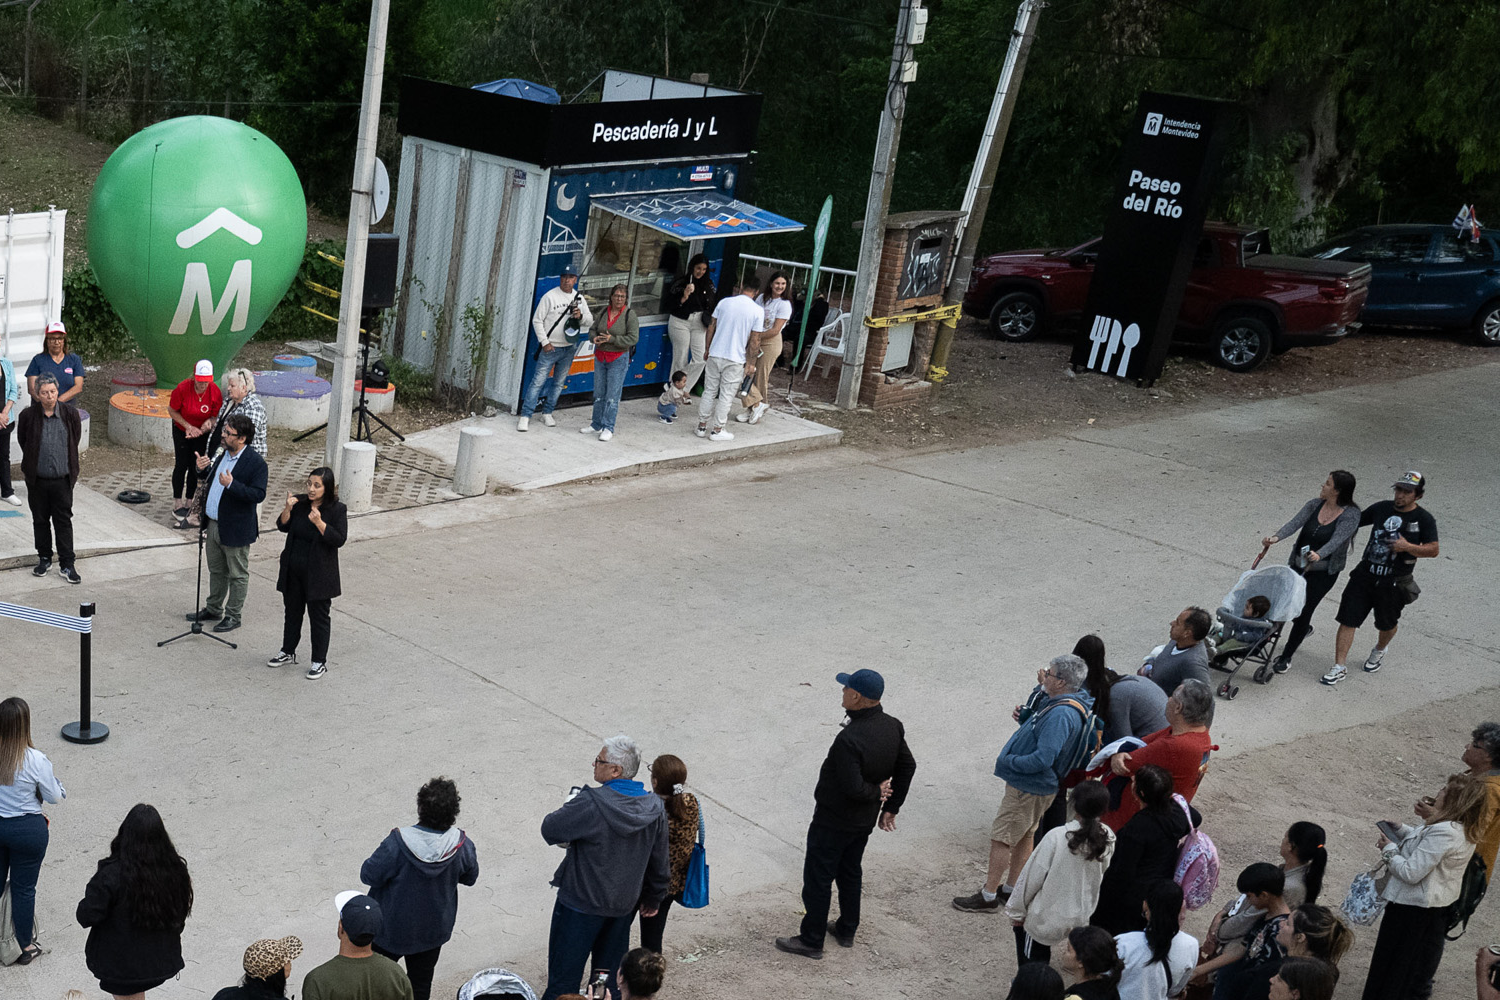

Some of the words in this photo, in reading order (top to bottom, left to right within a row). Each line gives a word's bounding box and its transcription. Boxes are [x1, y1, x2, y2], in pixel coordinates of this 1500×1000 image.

[592, 118, 679, 143] Pescadería
[682, 118, 692, 138] J
[693, 122, 706, 141] y
[708, 116, 718, 136] L
[1161, 126, 1200, 139] Montevideo
[1163, 118, 1201, 131] Intendencia
[1128, 169, 1182, 196] Paseo
[1122, 192, 1152, 213] del
[1153, 197, 1183, 219] Río
